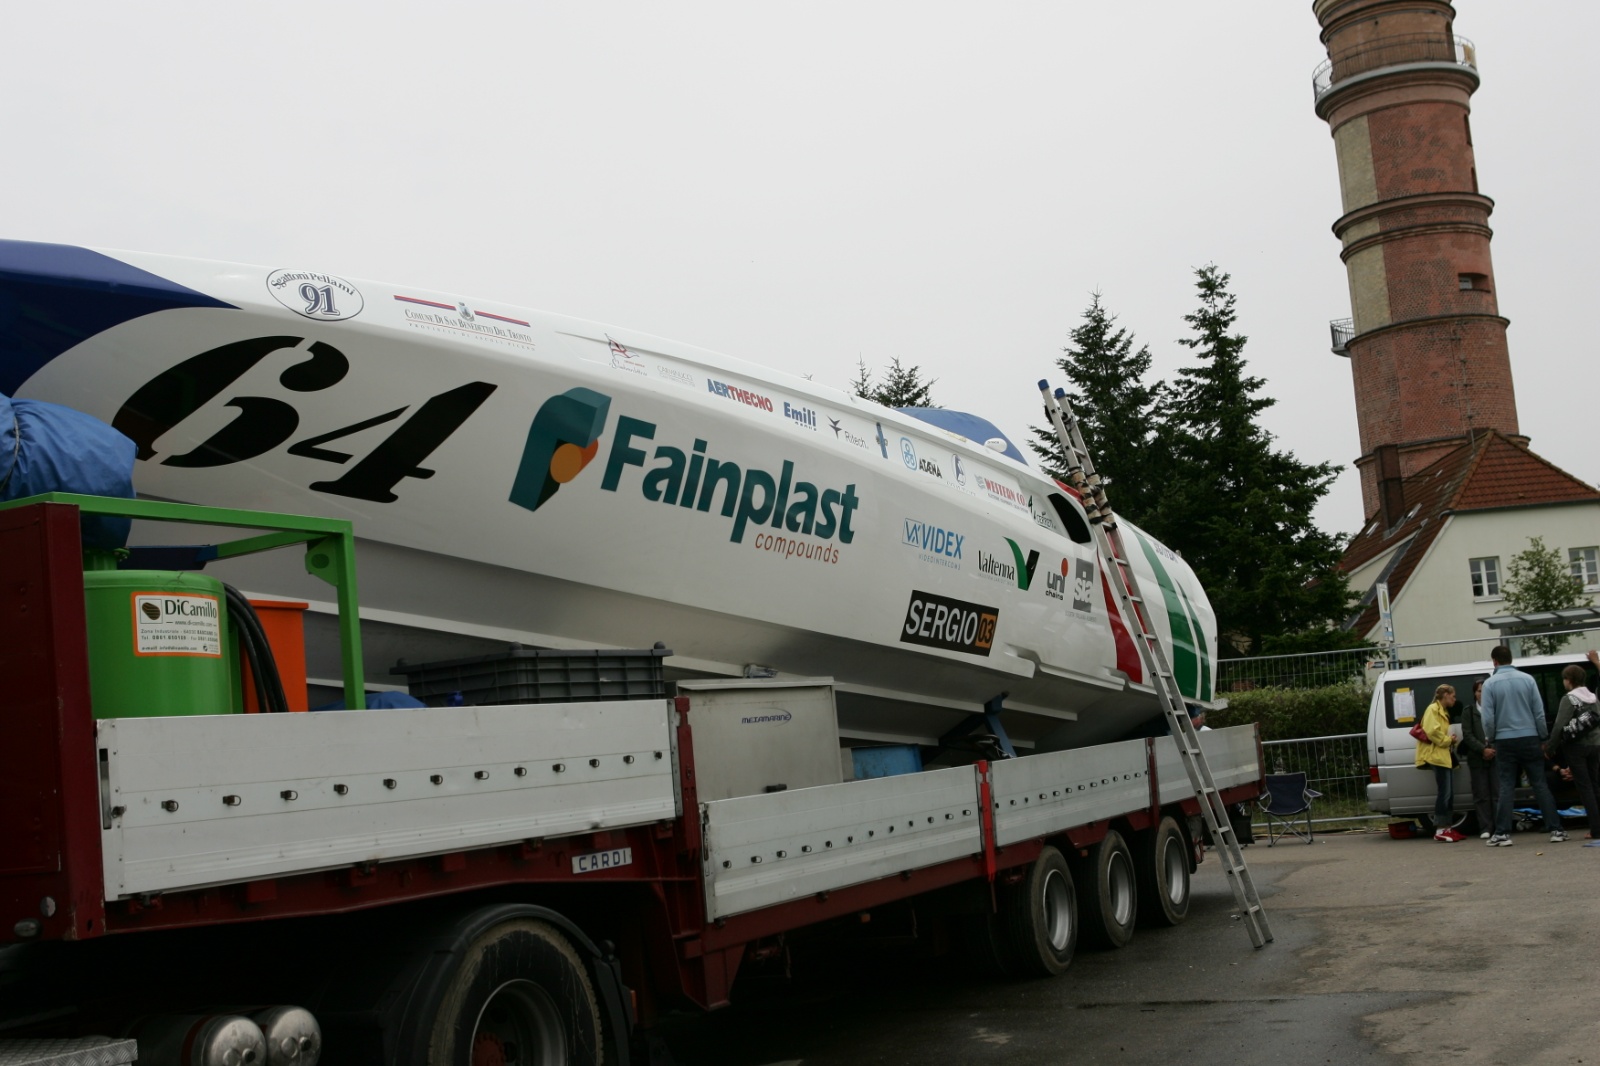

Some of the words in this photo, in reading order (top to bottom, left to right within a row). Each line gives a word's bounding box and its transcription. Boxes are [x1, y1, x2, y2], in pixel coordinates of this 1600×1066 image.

[299, 282, 340, 316] 91
[309, 272, 355, 296] Pellami
[707, 378, 774, 413] AERTHECNO
[110, 335, 498, 503] 64
[783, 402, 816, 427] Emili
[601, 414, 860, 544] Fainplast
[984, 478, 1017, 502] WESTERN
[755, 532, 839, 564] compounds
[922, 523, 964, 560] VIDEX
[978, 549, 1015, 581] Valtenna
[165, 599, 217, 619] DiCamillo
[905, 599, 978, 645] SERGIO
[978, 618, 995, 645] 03
[578, 849, 627, 872] CARDI
